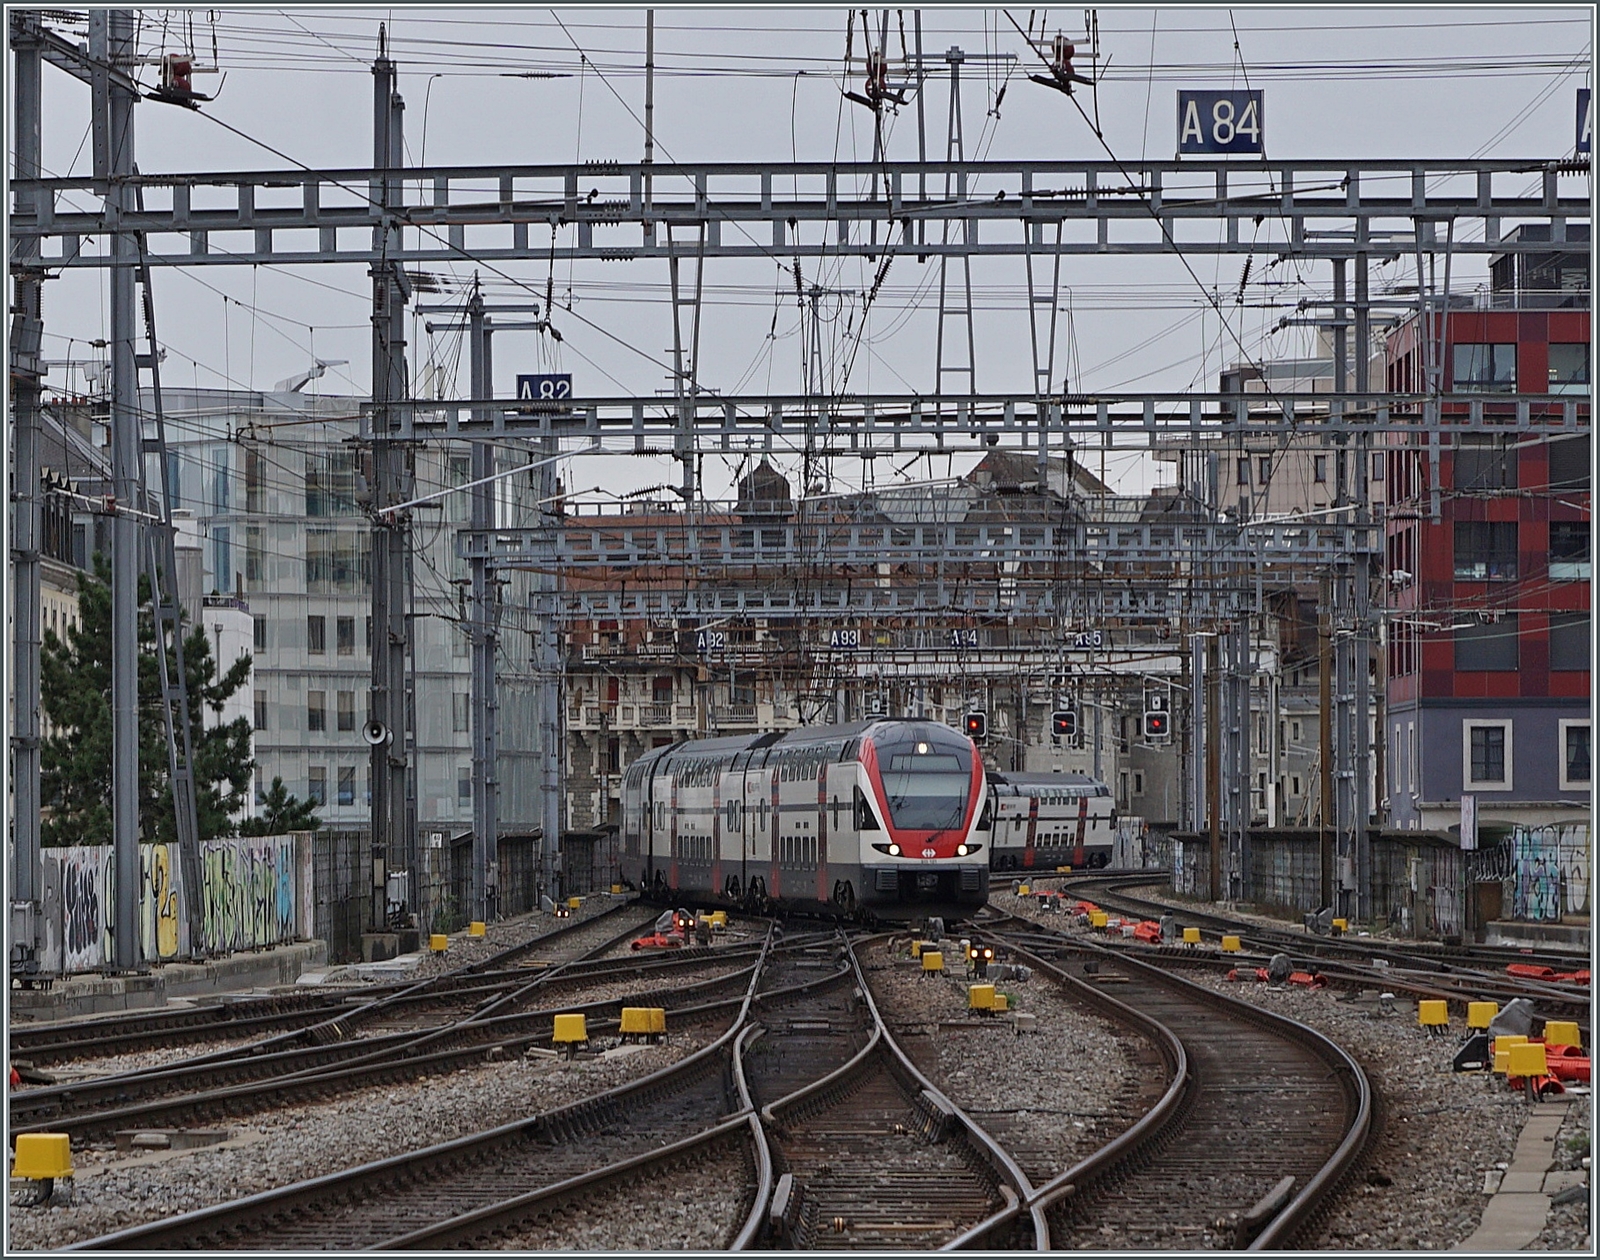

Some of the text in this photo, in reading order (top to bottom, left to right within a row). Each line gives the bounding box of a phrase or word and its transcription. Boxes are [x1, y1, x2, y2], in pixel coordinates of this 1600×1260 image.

[1181, 99, 1259, 144] A 84
[521, 380, 570, 399] A 82
[698, 632, 723, 647] A 92
[831, 630, 856, 645] A 93
[951, 630, 959, 645] A
[1075, 633, 1083, 645] A
